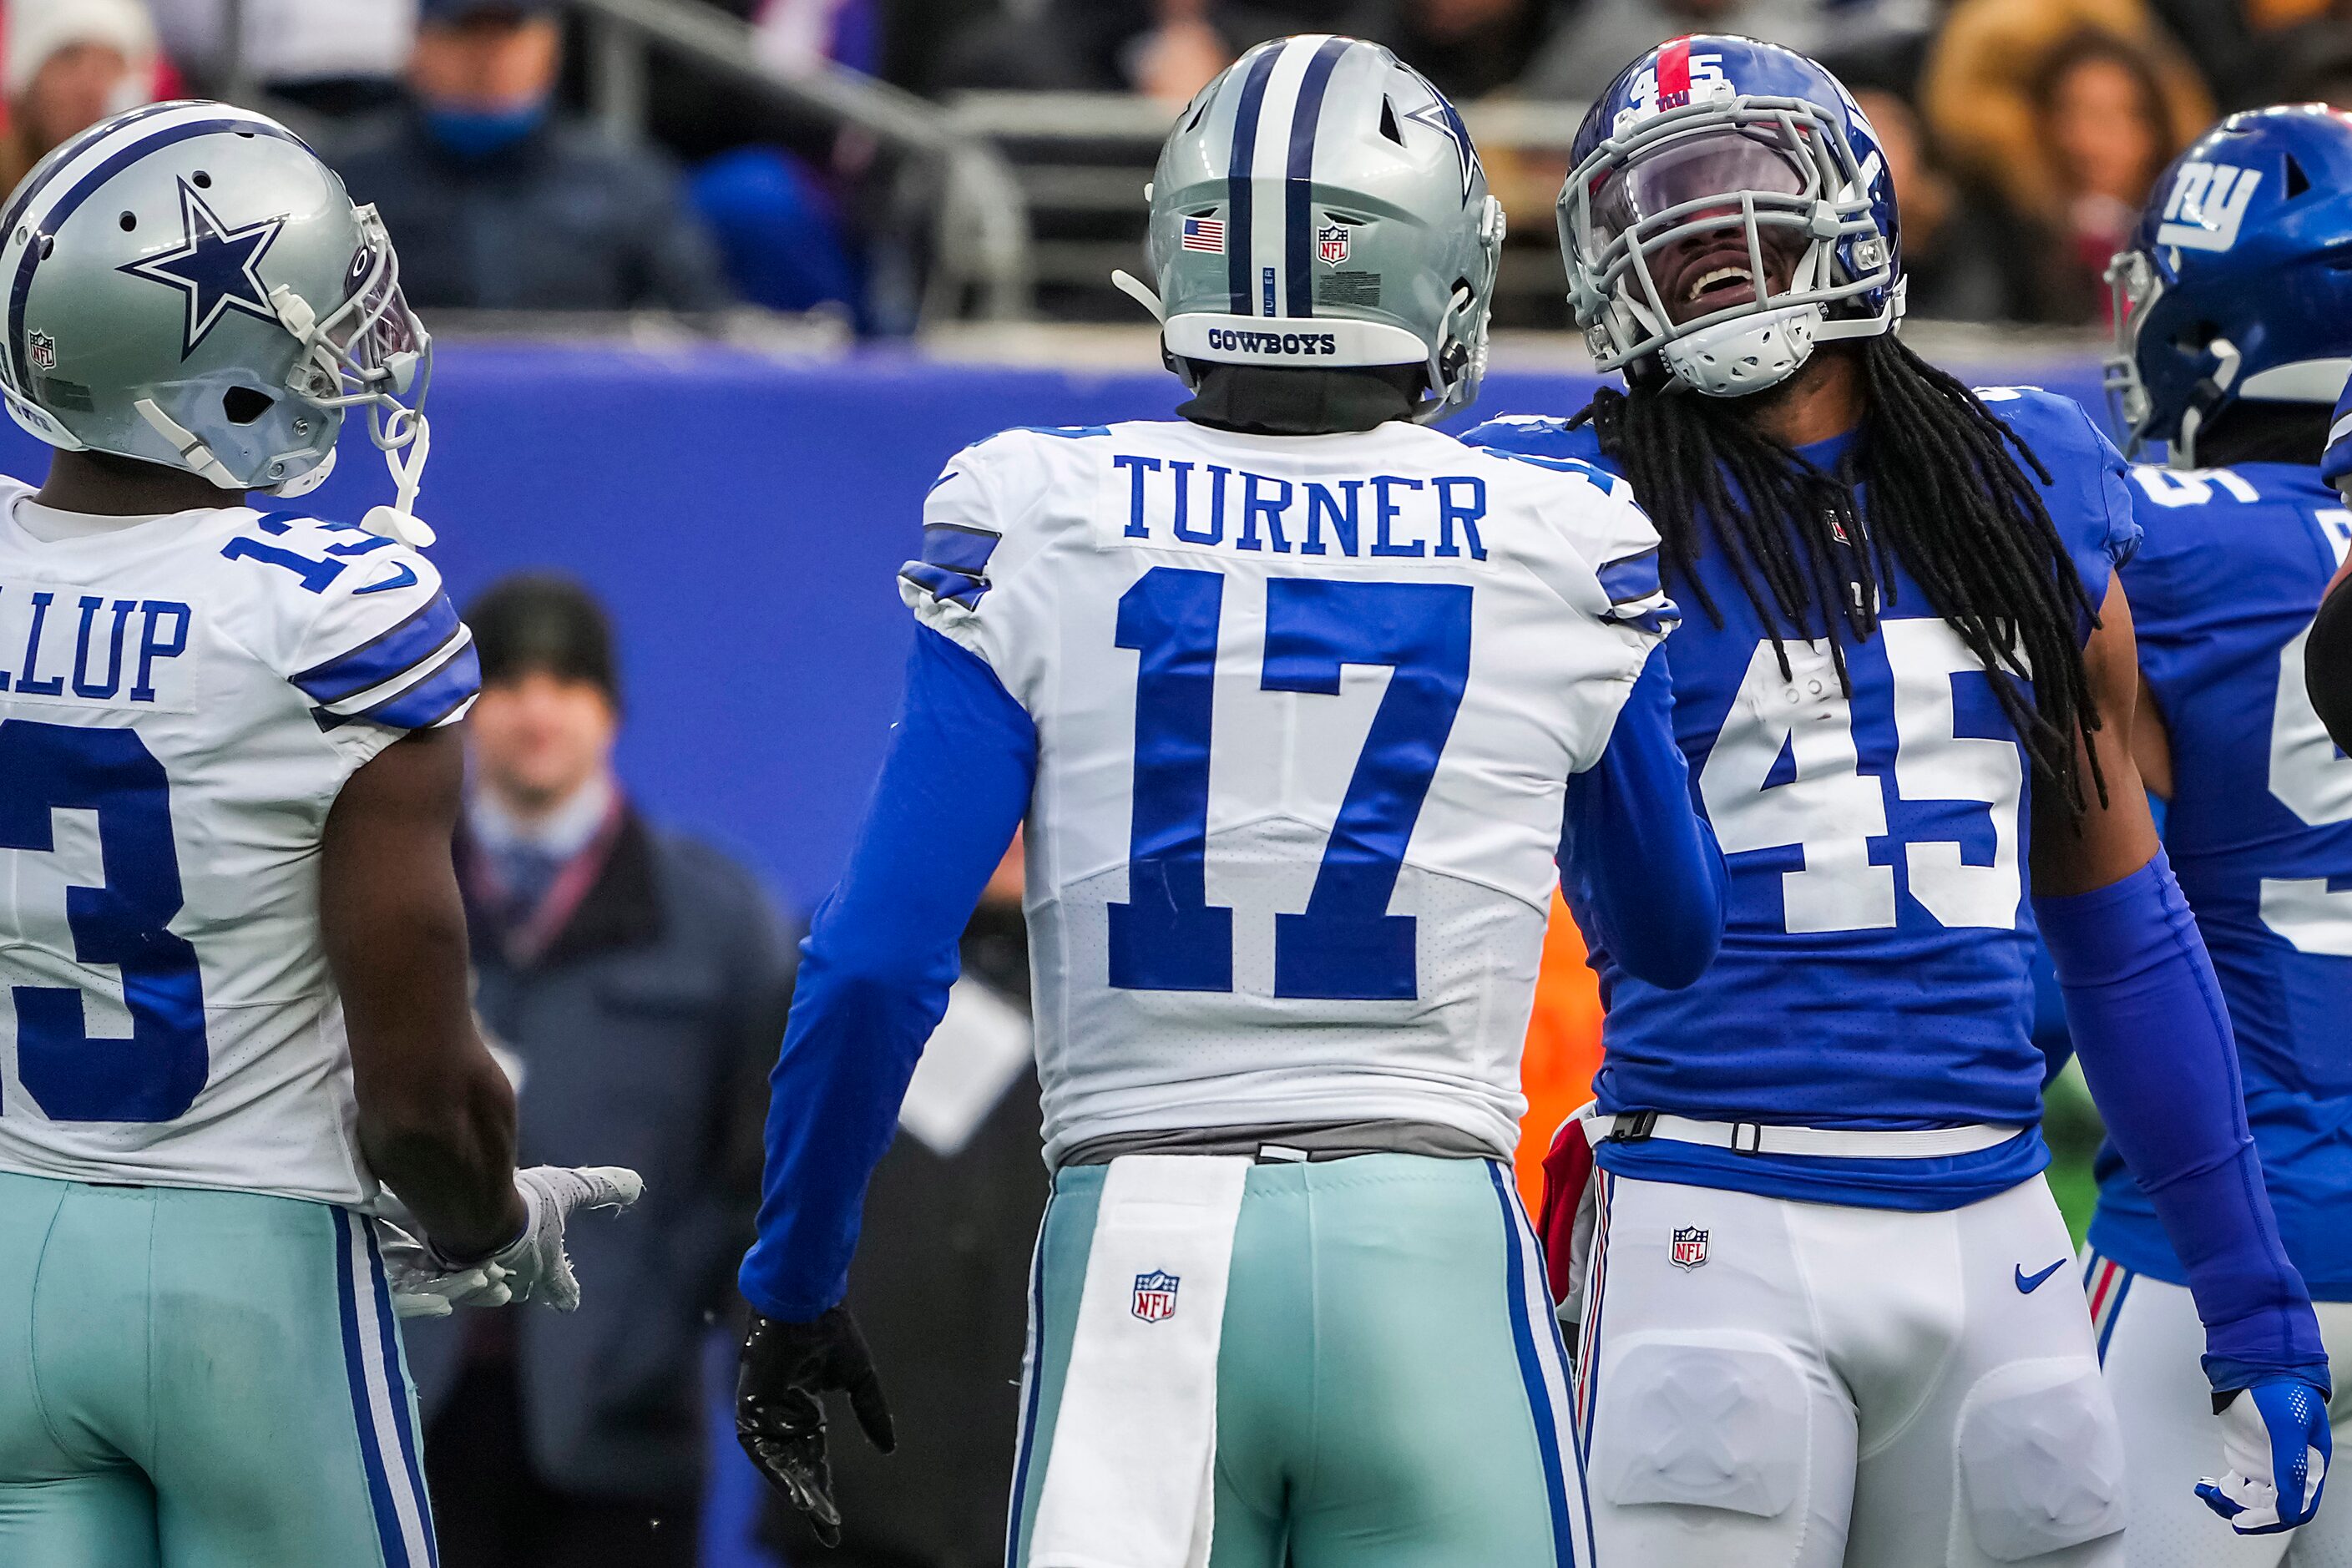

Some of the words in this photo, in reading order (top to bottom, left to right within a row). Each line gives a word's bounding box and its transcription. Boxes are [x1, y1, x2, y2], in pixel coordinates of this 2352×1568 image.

[1629, 53, 1726, 123] 45
[1321, 242, 1346, 260] NFL
[32, 345, 53, 365] NFL
[1208, 328, 1336, 355] COWBOYS
[1113, 455, 1488, 562] TURNER
[0, 587, 192, 703] LUP
[1107, 566, 1474, 1000] 17
[1698, 616, 2033, 933] 45
[0, 718, 209, 1122] 3
[1675, 1243, 1703, 1262] NFL
[1137, 1292, 1172, 1318] NFL
